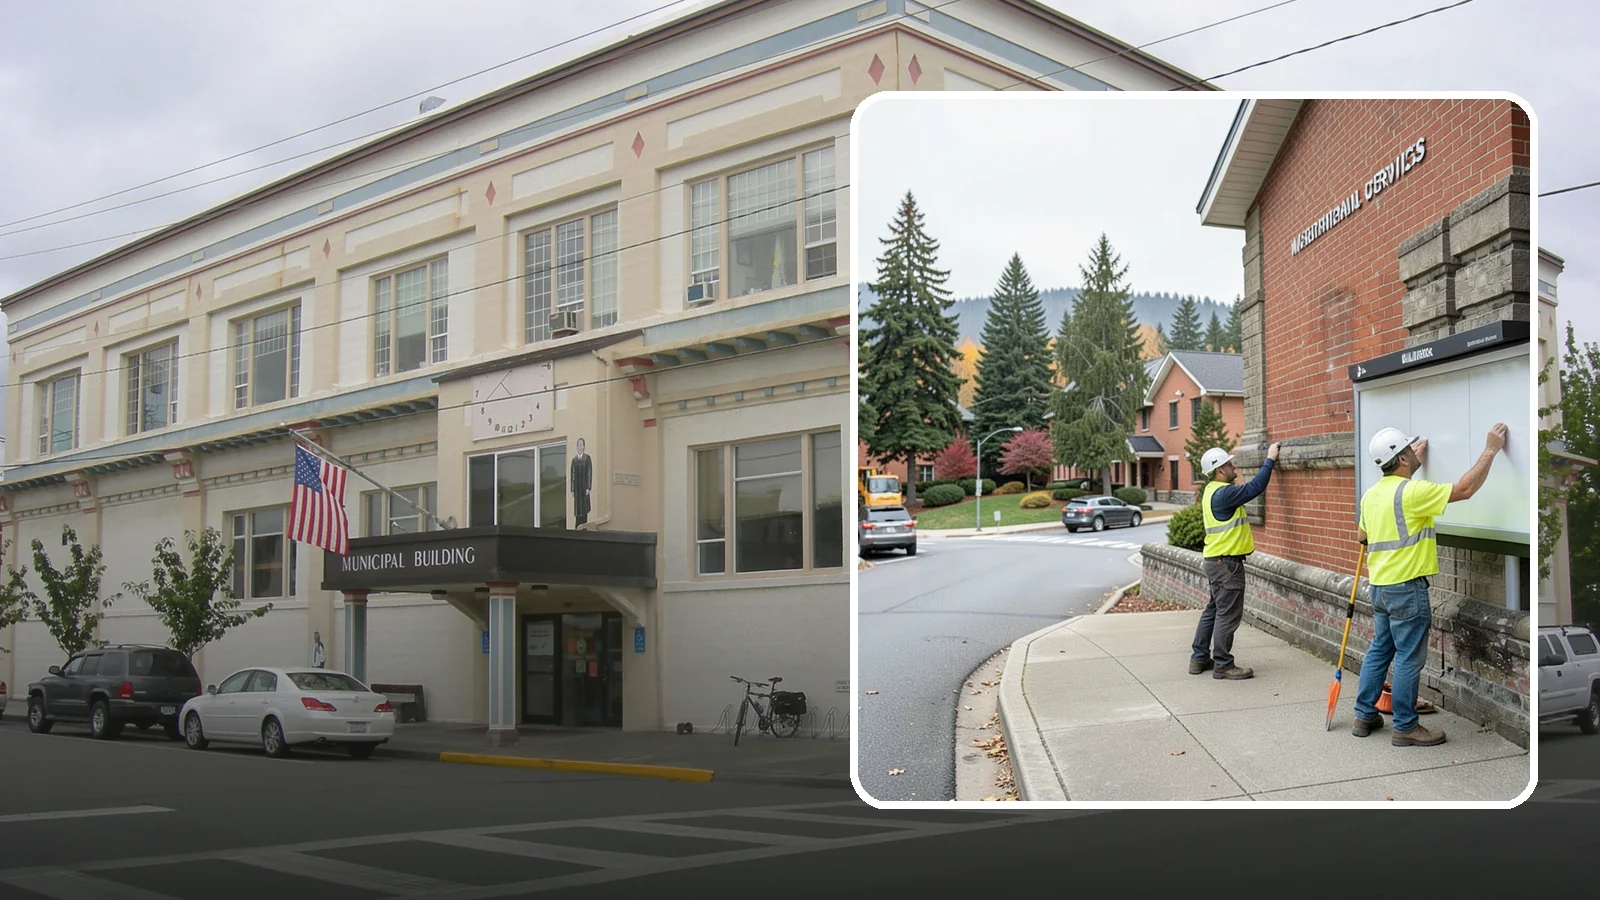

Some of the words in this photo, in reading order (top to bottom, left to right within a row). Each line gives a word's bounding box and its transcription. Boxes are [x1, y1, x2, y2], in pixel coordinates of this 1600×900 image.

[481, 407, 485, 415] 8
[488, 417, 493, 426] 9
[494, 423, 500, 432] 10
[501, 425, 506, 433] 11
[507, 425, 514, 433] 12
[521, 420, 526, 428] 2
[529, 414, 533, 422] 3
[536, 402, 540, 410] 4
[342, 552, 405, 572] MUNICIPAL
[414, 546, 475, 567] BUILDING
